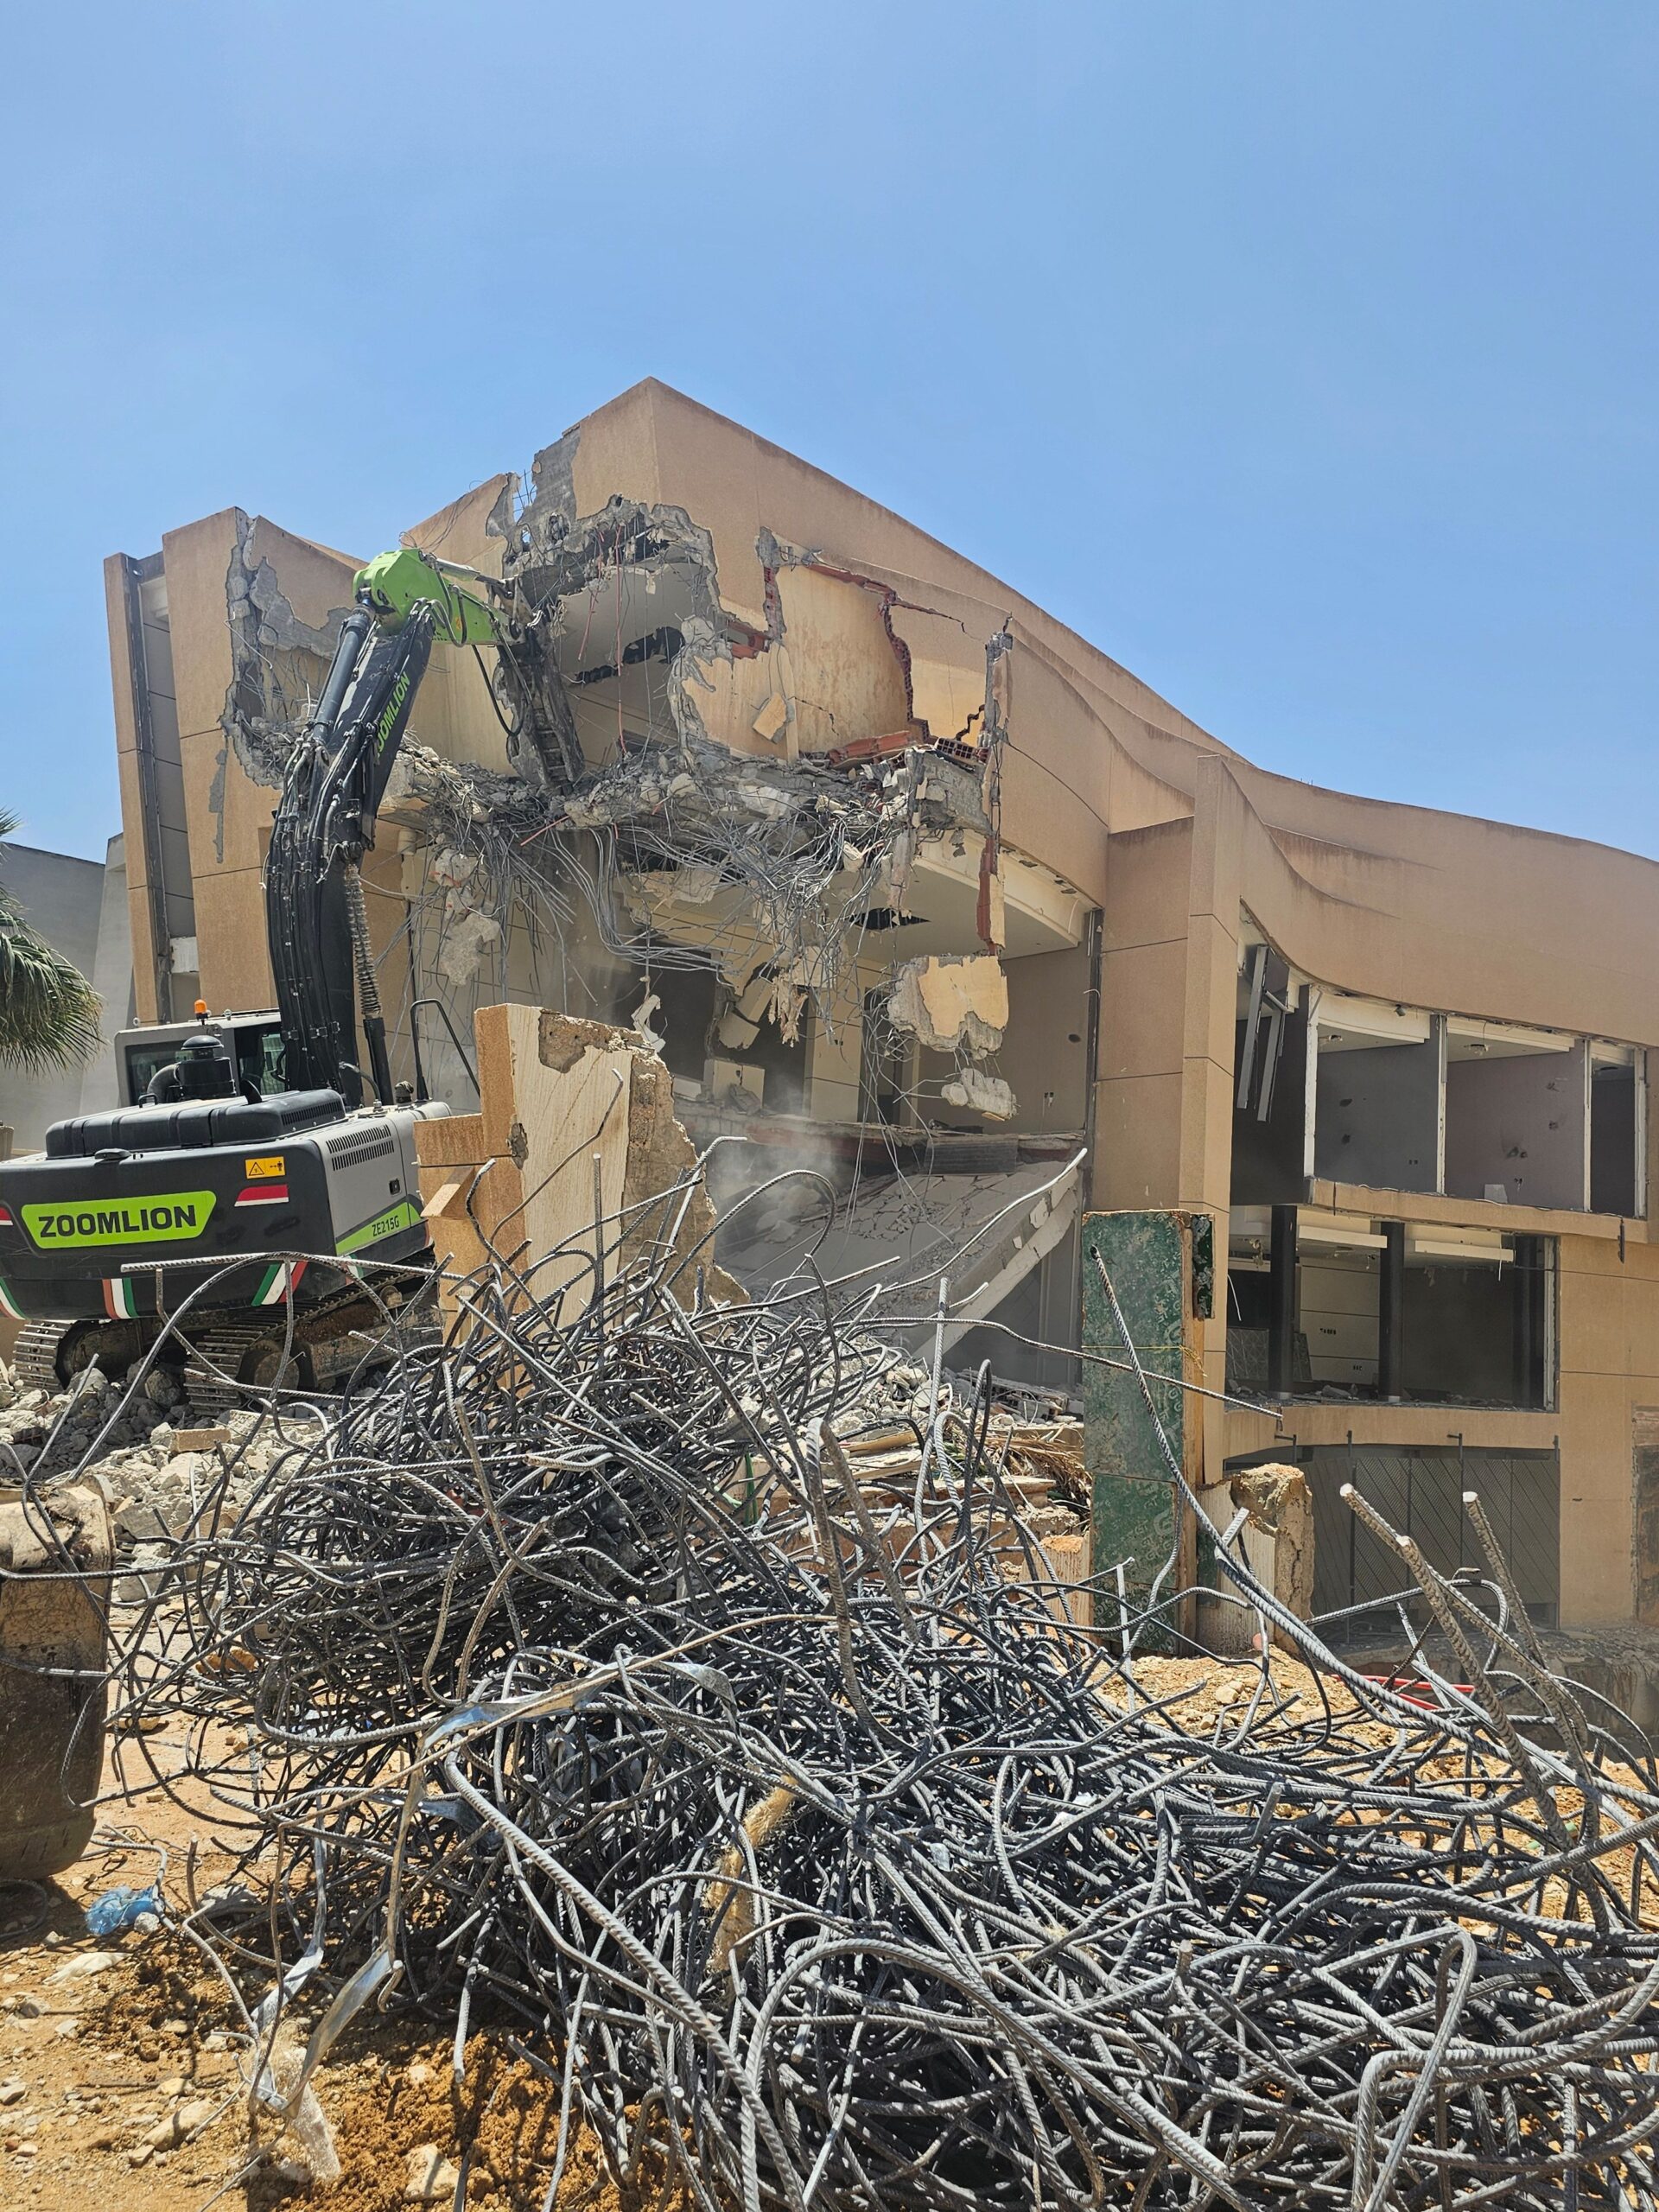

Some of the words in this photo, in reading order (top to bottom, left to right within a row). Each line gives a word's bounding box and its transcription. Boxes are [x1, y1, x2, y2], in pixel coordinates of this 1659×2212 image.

[38, 1205, 197, 1238] ZOOMLION
[372, 1215, 399, 1236] ZE215G
[1139, 1611, 1167, 1640] WOD
